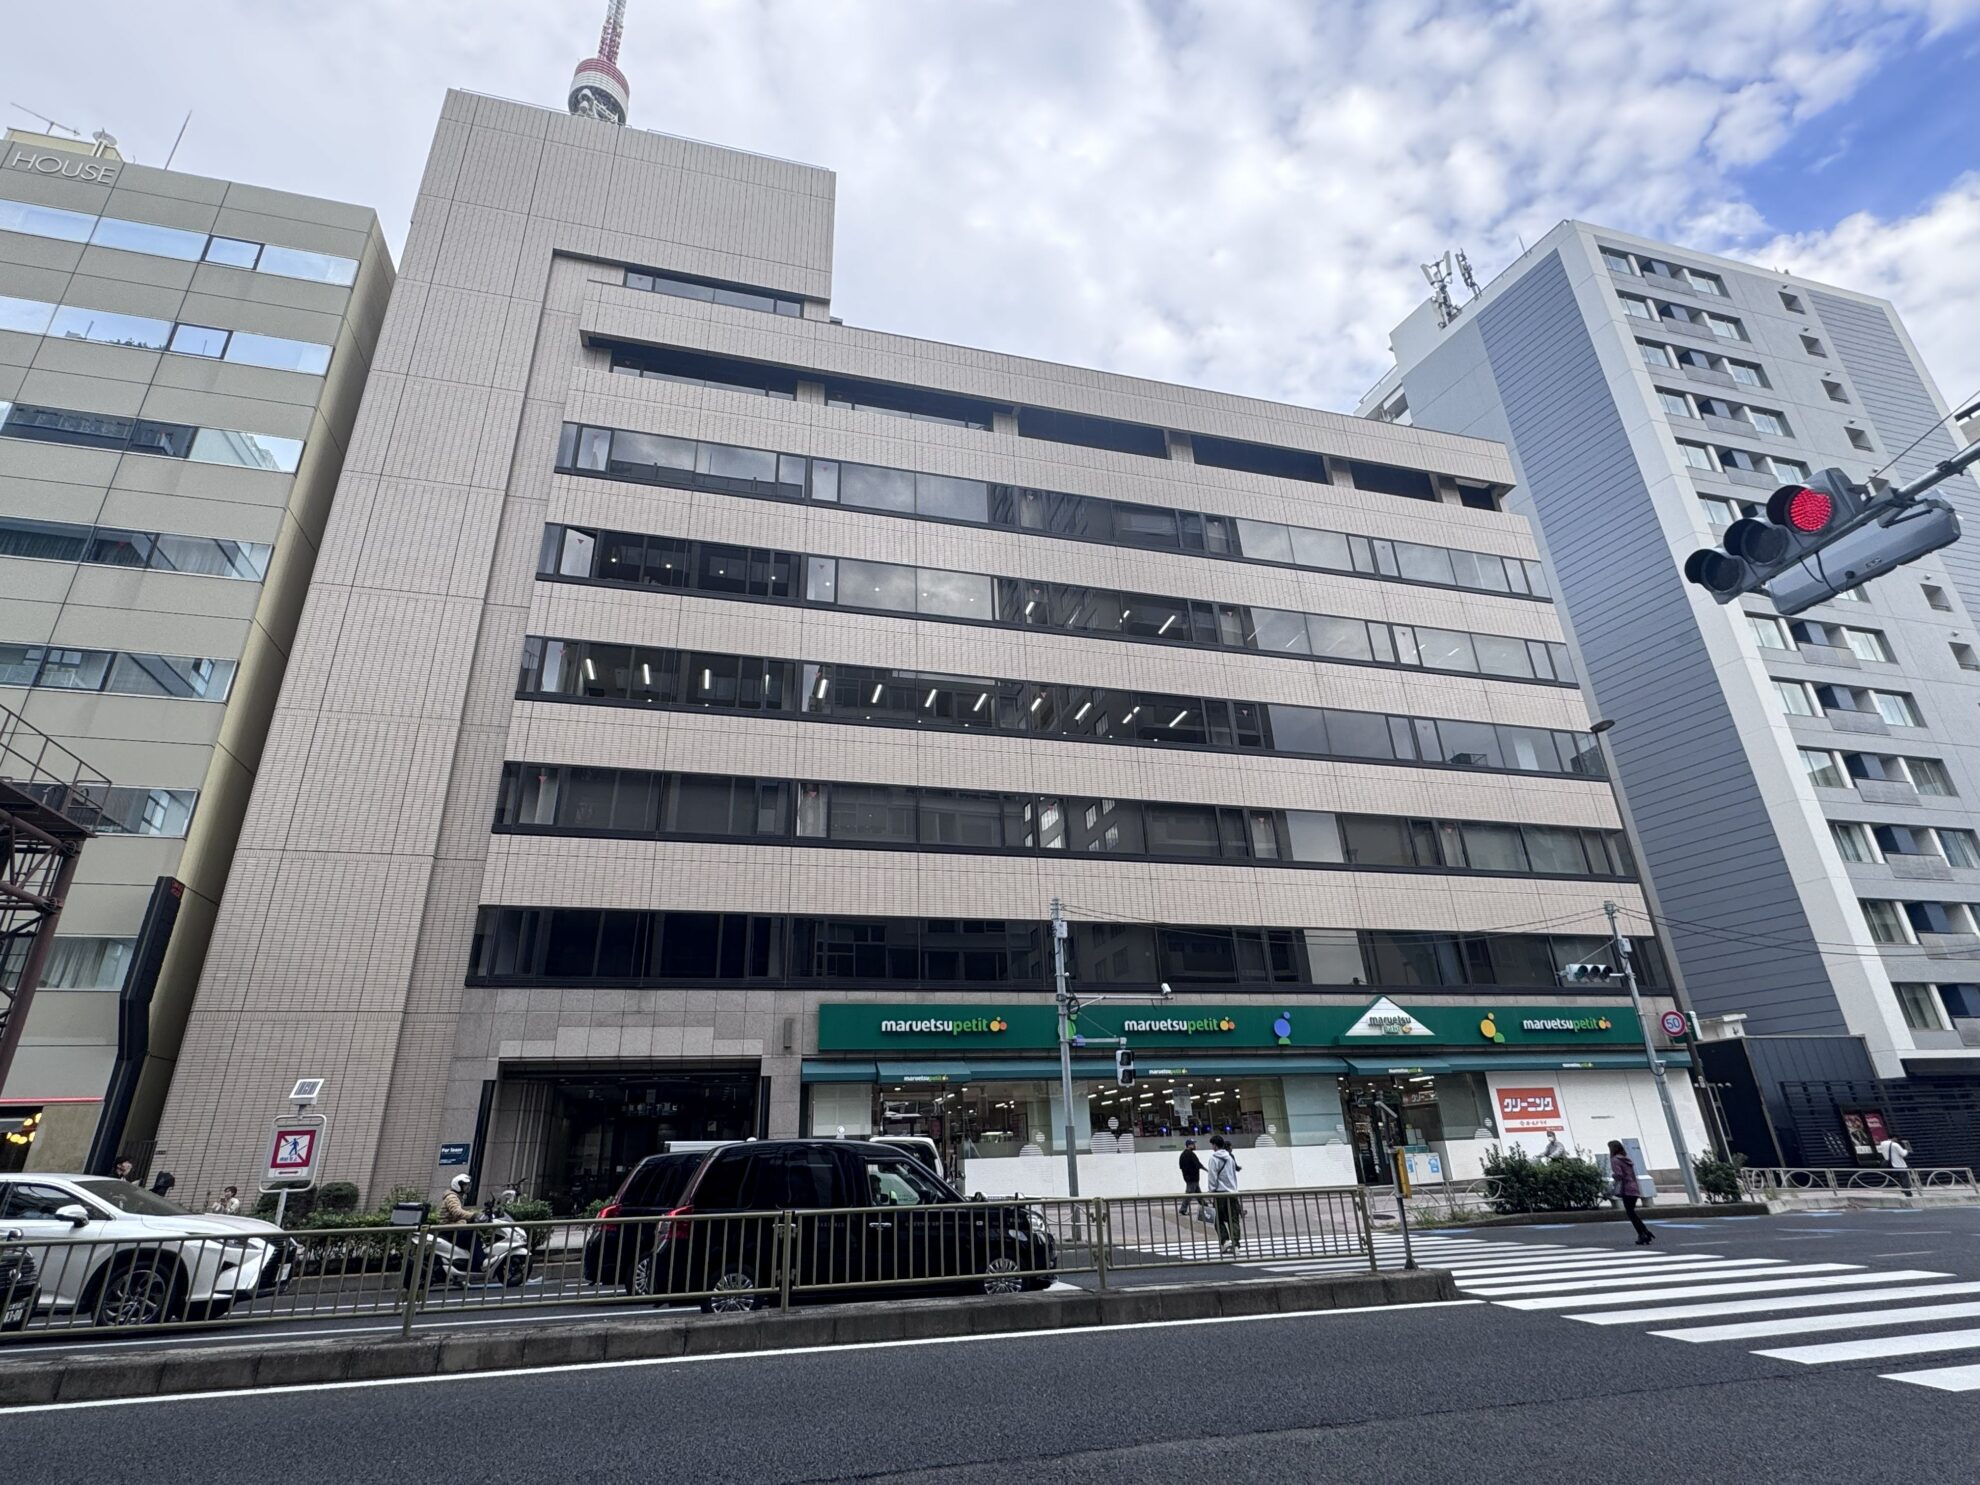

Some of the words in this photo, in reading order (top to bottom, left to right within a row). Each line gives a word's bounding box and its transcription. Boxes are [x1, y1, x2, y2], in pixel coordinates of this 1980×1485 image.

[11, 151, 116, 184] HOUSE
[1666, 1017, 1681, 1030] 50
[1504, 1098, 1553, 1111] クリーニング
